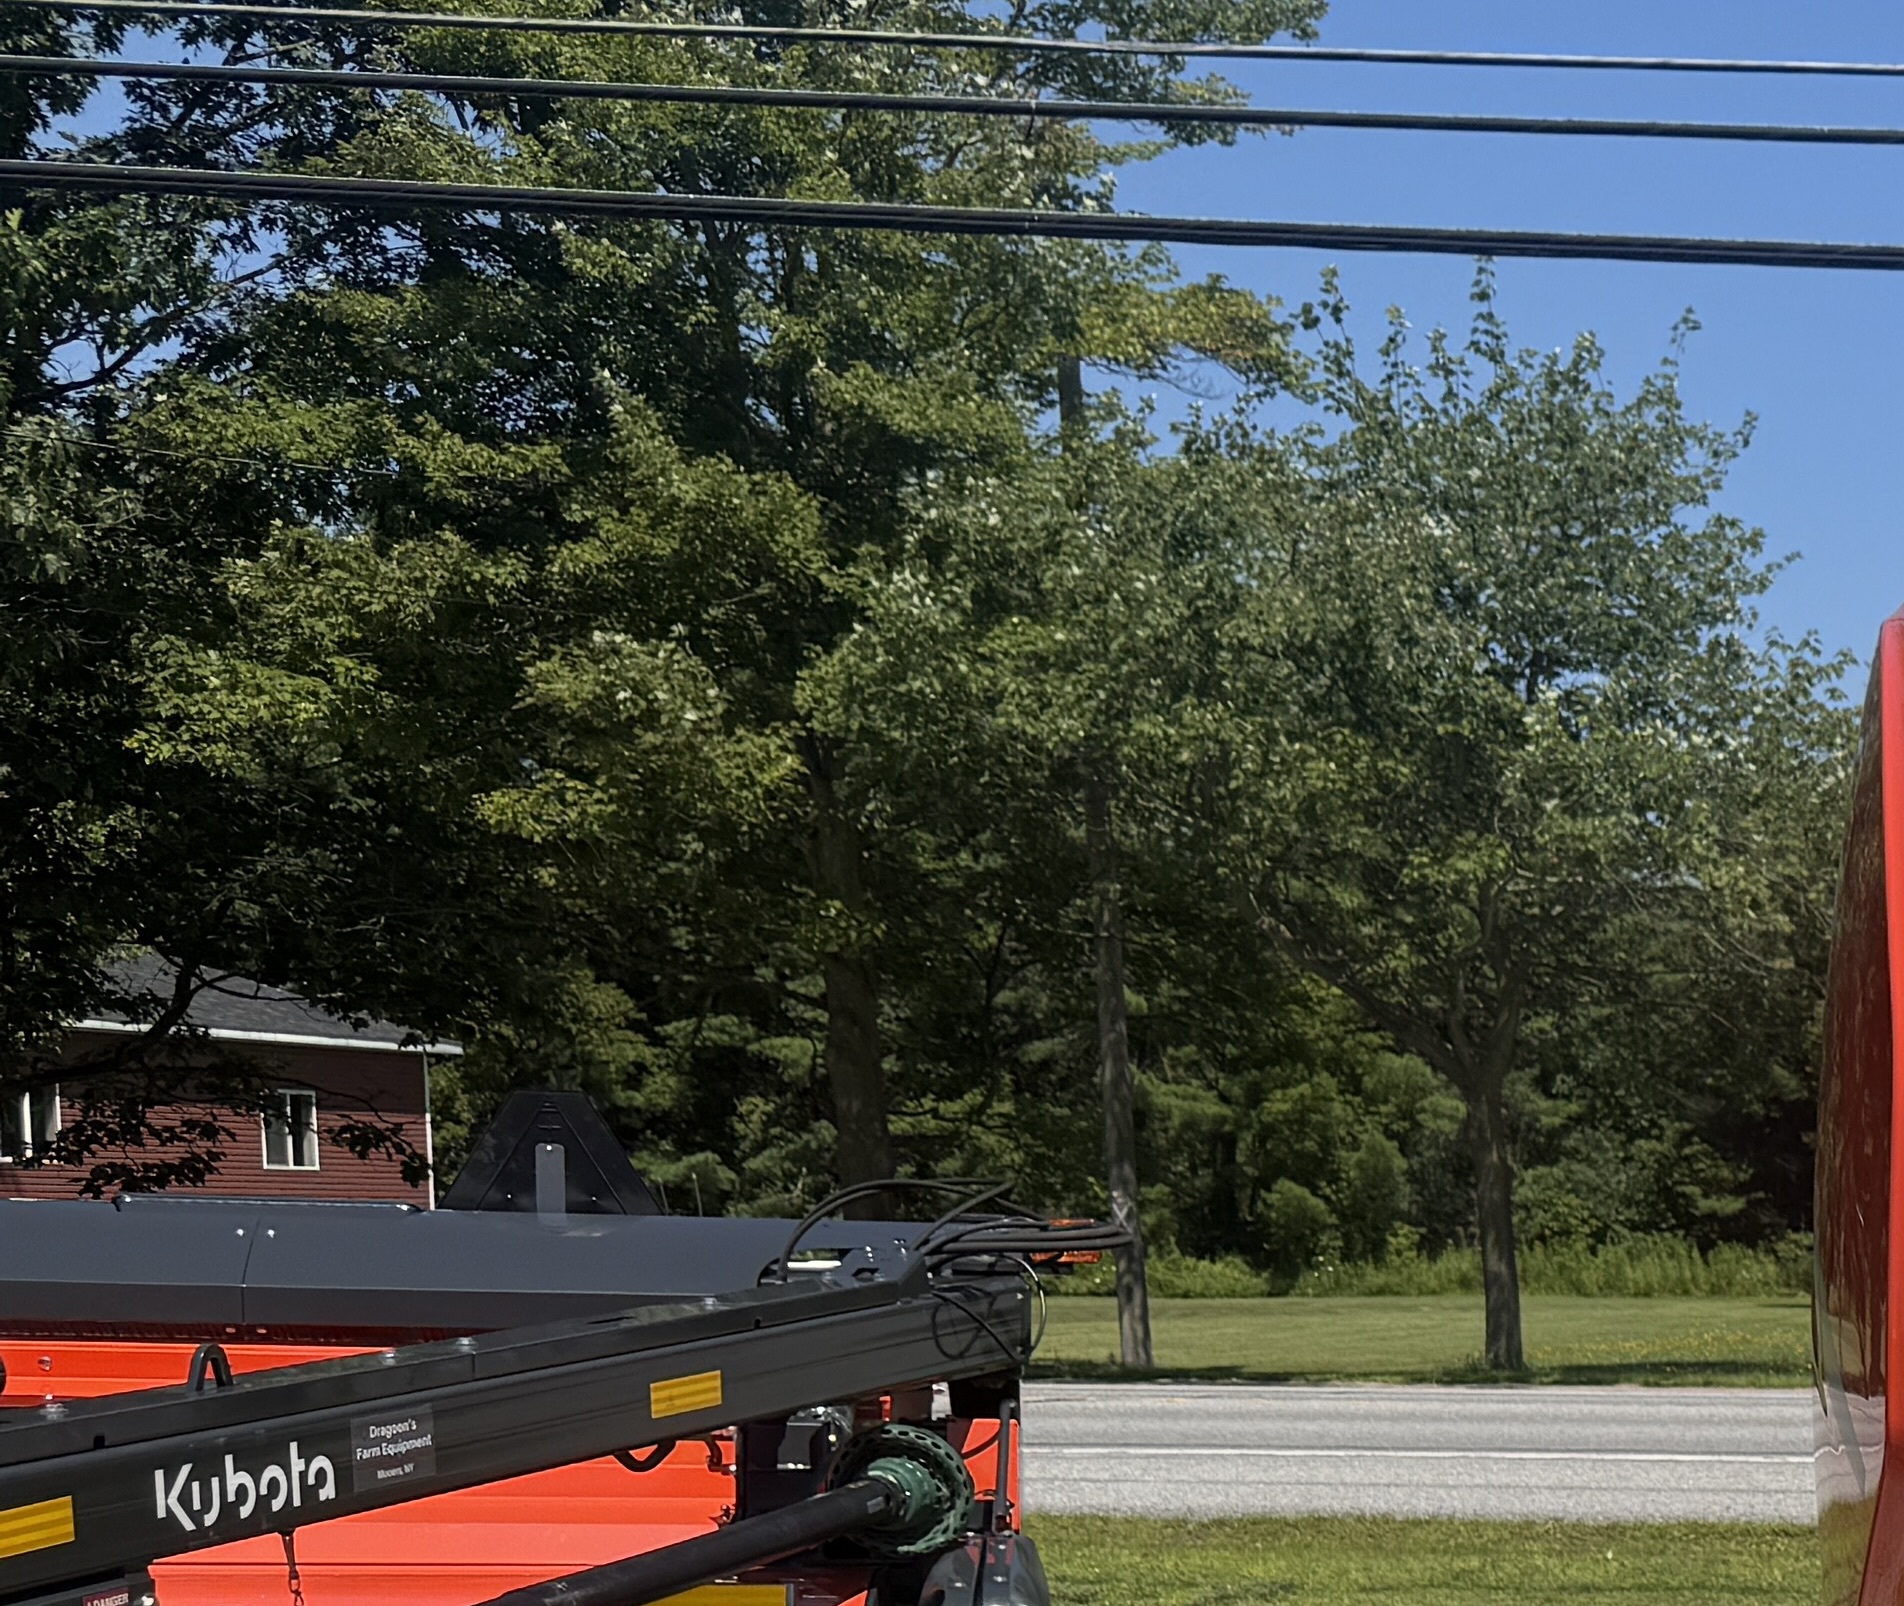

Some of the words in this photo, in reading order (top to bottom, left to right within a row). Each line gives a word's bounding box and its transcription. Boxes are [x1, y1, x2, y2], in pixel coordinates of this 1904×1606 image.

[369, 1418, 417, 1439] Dragoon's
[356, 1446, 381, 1460] Farm
[381, 1434, 432, 1457] Equipment
[154, 1441, 336, 1531] Kubota
